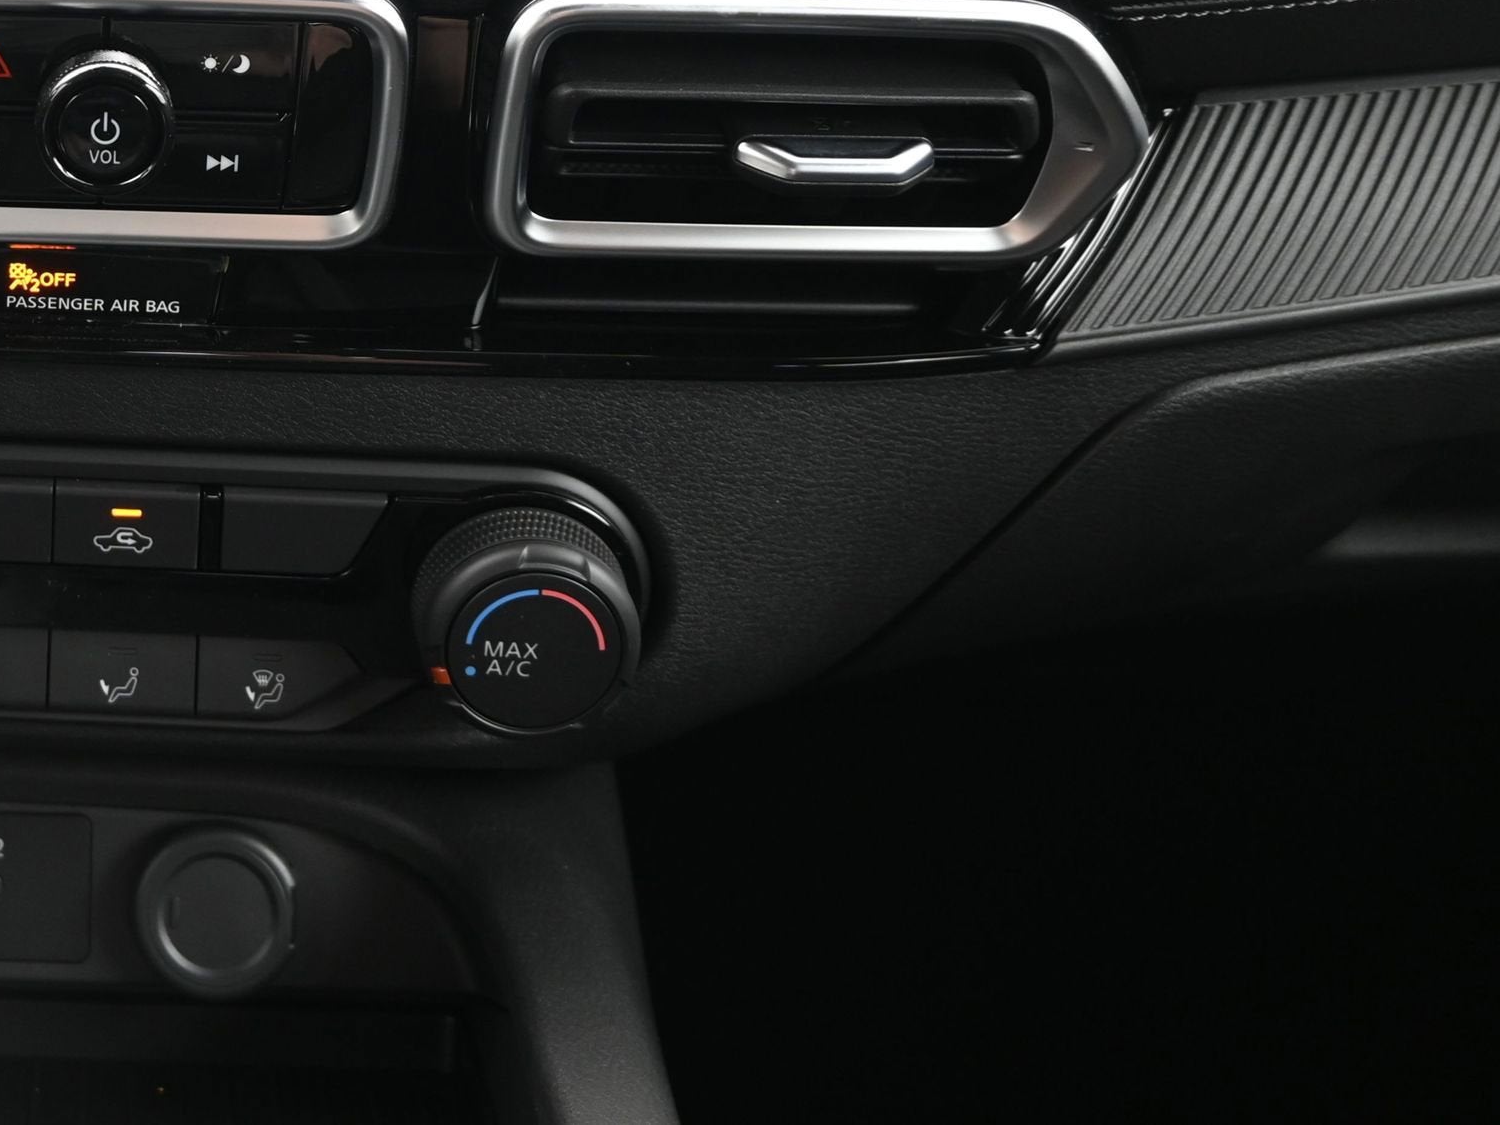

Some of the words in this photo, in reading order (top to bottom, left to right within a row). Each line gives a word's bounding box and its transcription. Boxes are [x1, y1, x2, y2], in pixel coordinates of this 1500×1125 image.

[89, 150, 120, 164] VOL
[40, 272, 76, 287] OFF
[7, 296, 104, 311] PASSENGER
[111, 300, 139, 312] AIR
[146, 300, 179, 313] BAG
[484, 641, 538, 659] MAX
[486, 660, 531, 677] A/C
